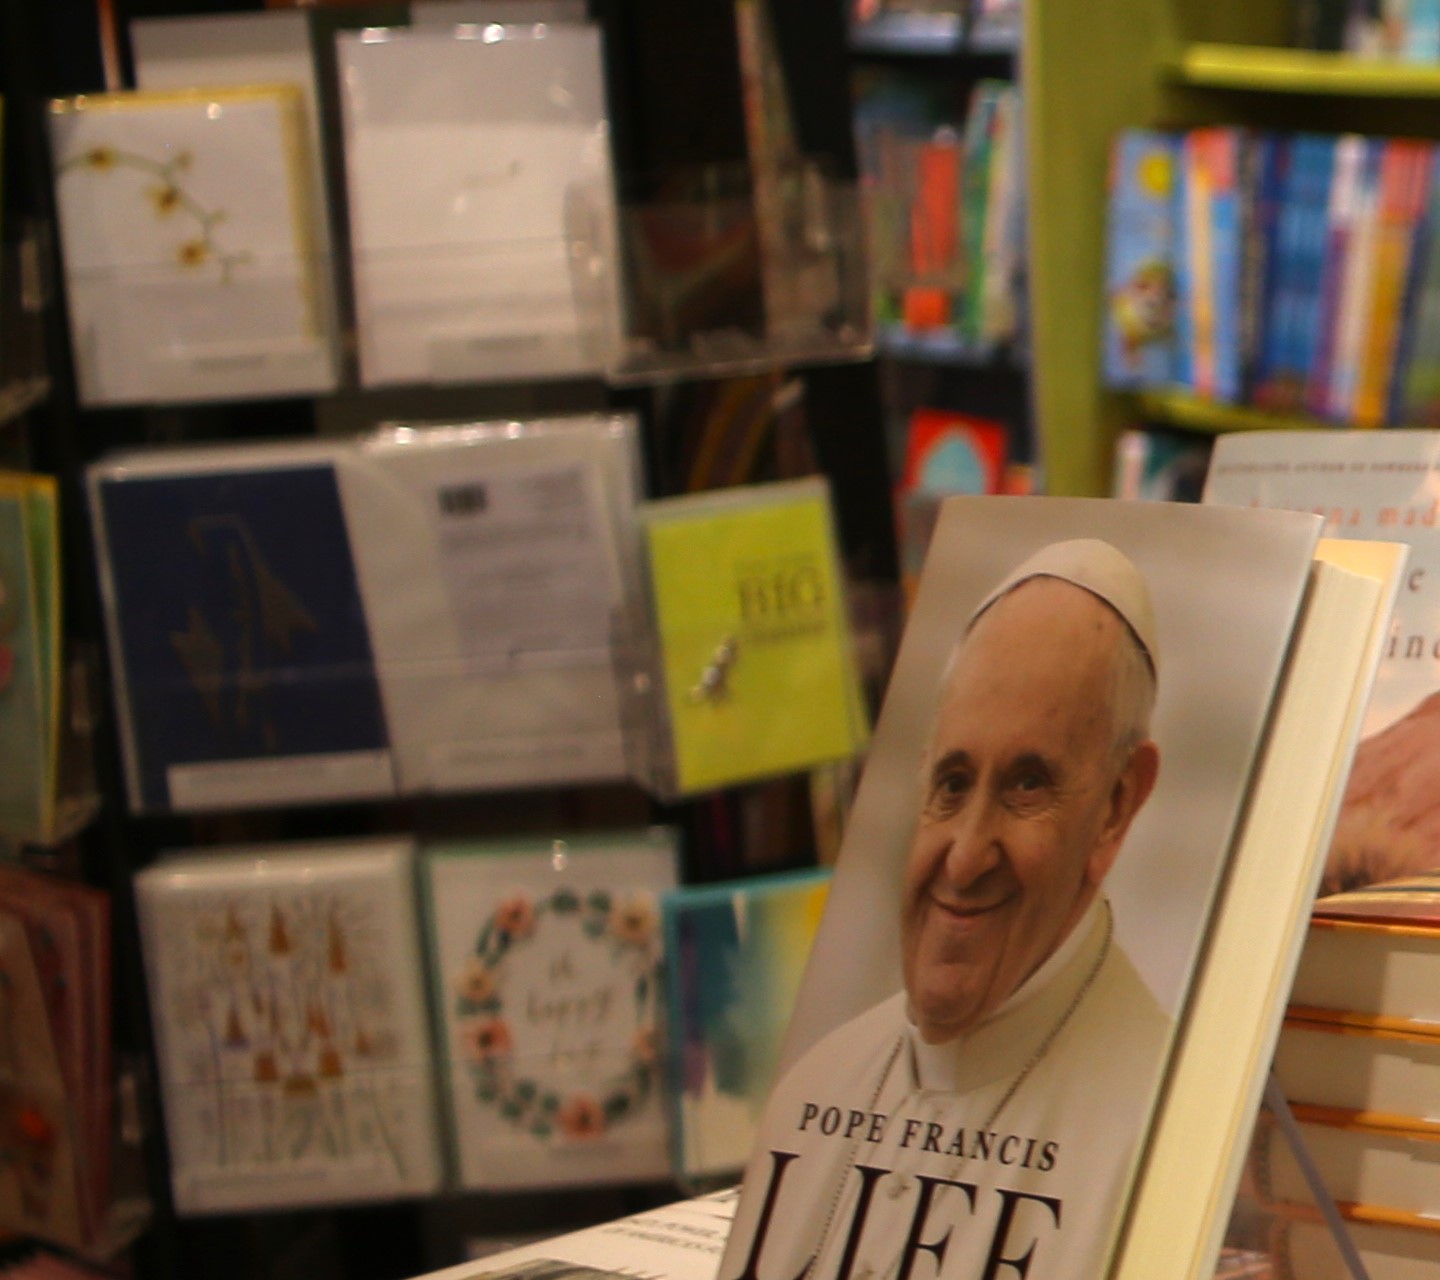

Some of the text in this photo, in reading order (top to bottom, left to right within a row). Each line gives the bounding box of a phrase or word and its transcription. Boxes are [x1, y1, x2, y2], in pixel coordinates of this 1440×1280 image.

[737, 567, 826, 622] BIG
[799, 1102, 1060, 1172] POPE FRANCIS
